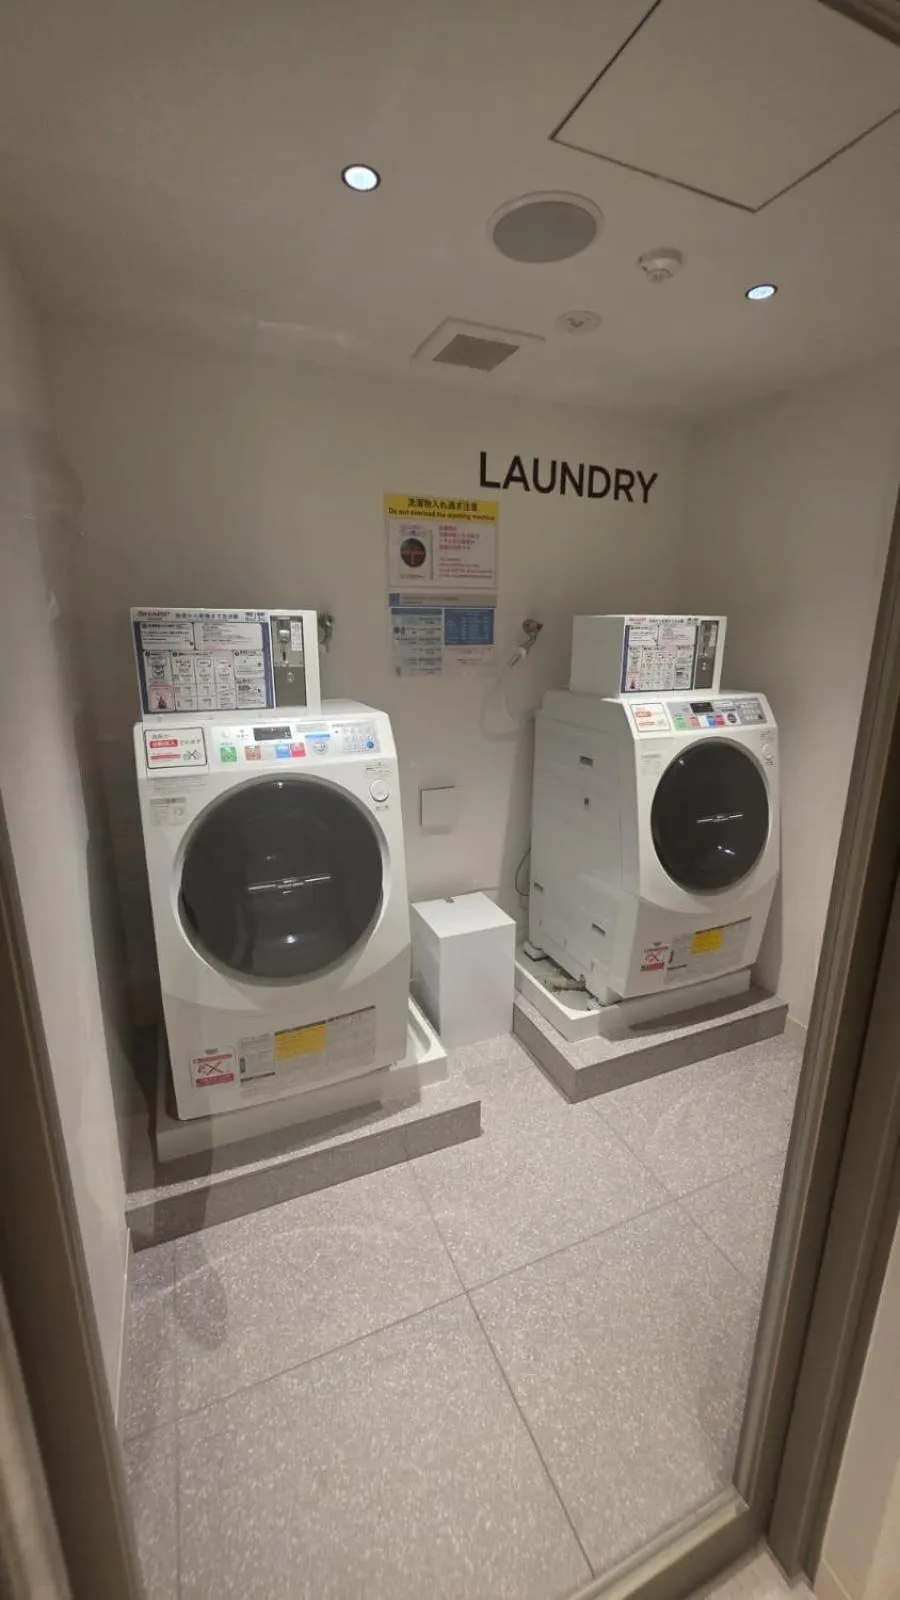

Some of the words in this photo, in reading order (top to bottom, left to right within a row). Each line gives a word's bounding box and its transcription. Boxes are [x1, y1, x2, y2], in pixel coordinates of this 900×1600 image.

[480, 451, 658, 504] LAUNDRY
[388, 507, 397, 515] Do
[399, 508, 409, 516] not
